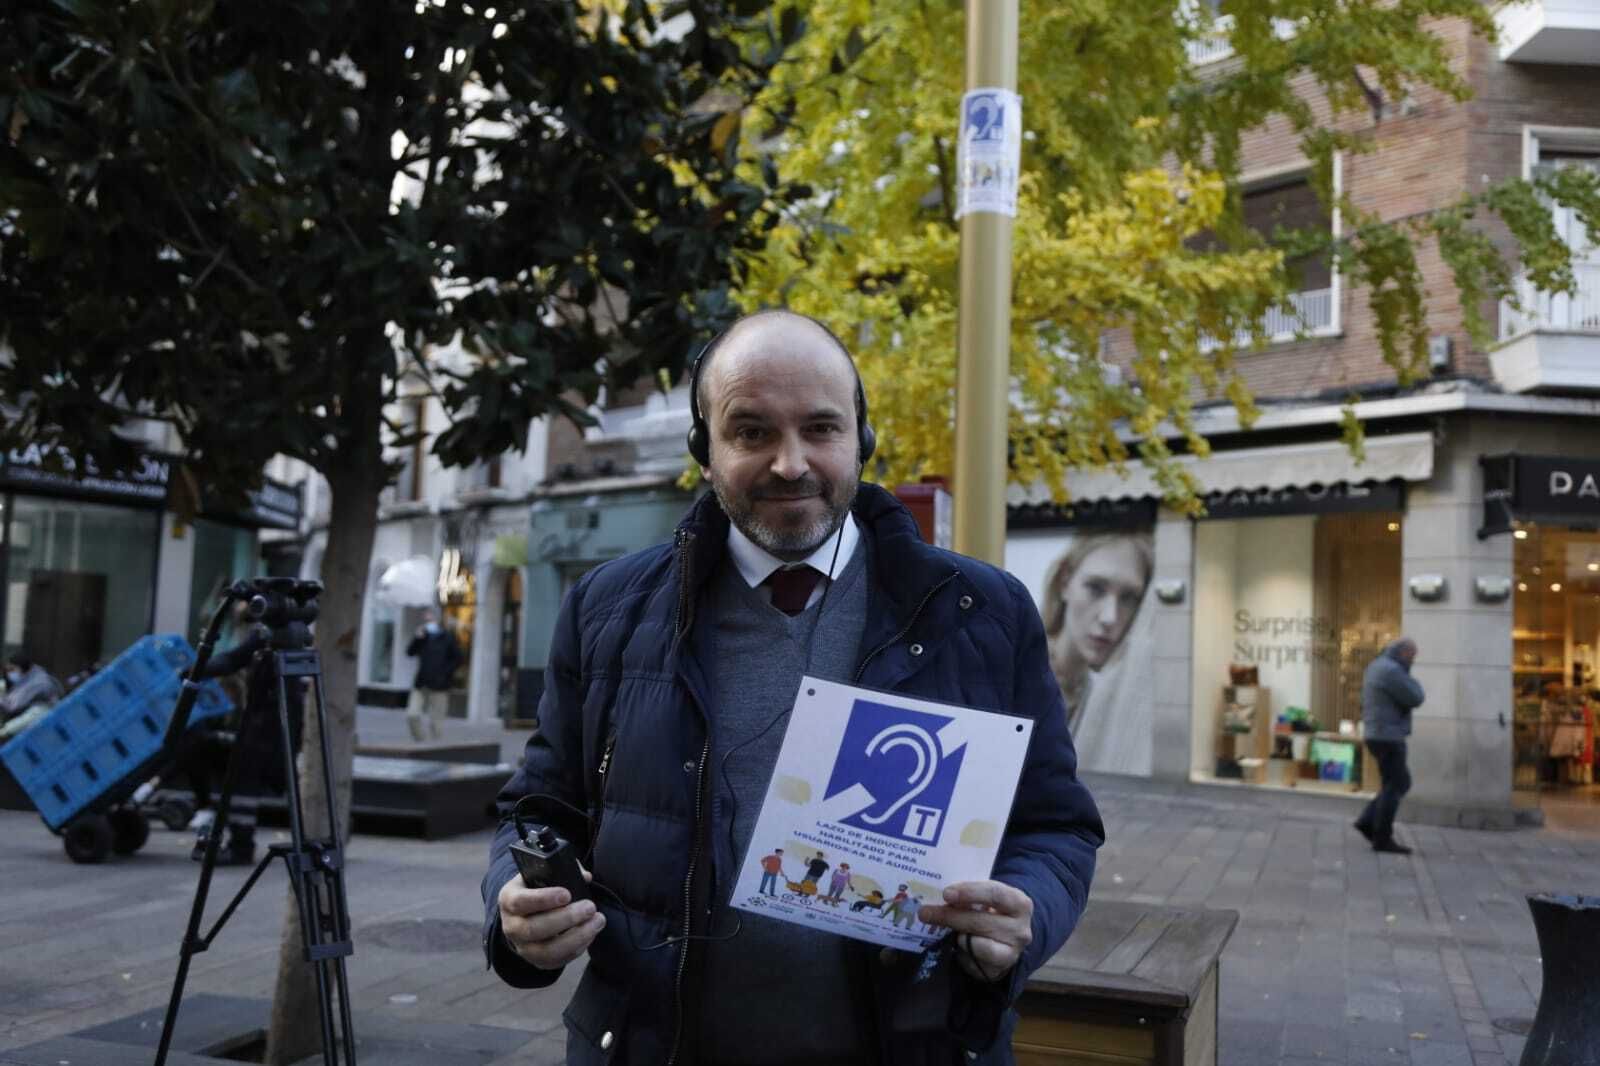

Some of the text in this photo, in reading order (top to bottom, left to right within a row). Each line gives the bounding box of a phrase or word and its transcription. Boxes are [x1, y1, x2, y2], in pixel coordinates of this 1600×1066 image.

[816, 820, 844, 833] LAZO
[847, 828, 862, 838] DE
[915, 808, 936, 836] T
[819, 829, 917, 864] HABILITADO PARA
[868, 853, 883, 863] DE
